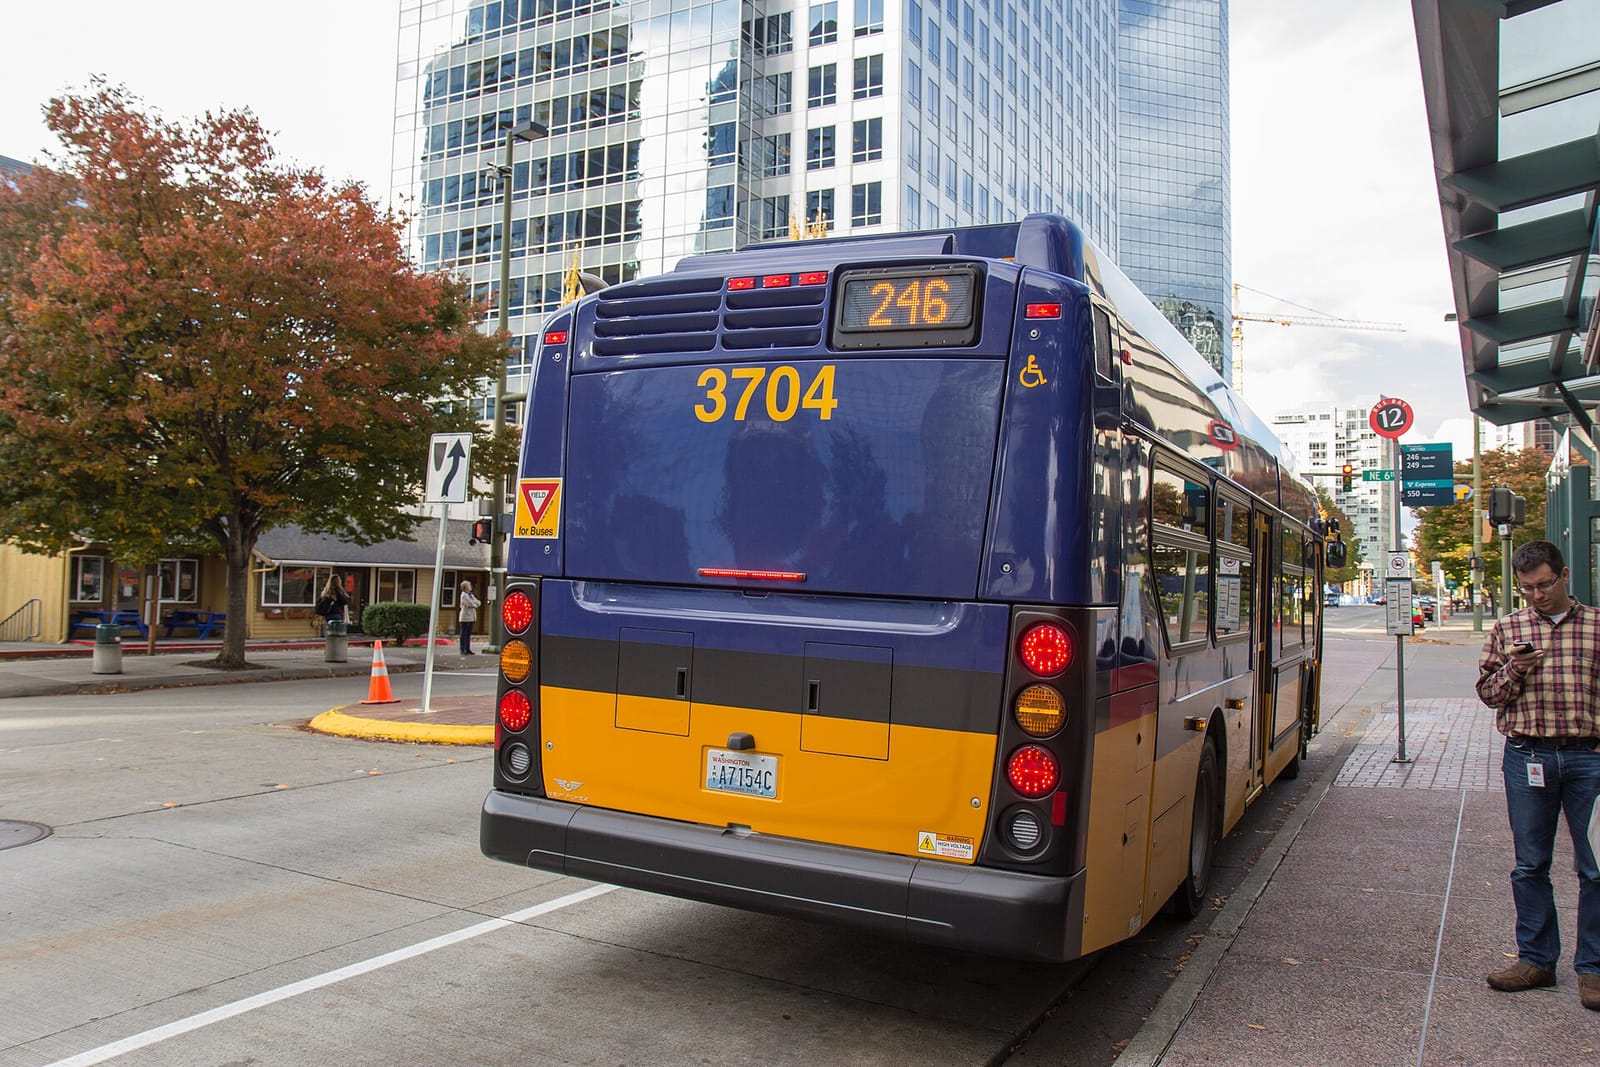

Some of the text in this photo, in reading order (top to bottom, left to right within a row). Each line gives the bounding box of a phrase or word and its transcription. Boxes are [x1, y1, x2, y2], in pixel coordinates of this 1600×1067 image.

[868, 280, 949, 327] 246
[694, 365, 838, 423] 3704
[1379, 407, 1404, 428] 12
[1369, 471, 1381, 481] NE
[519, 525, 554, 536] for Buses
[712, 756, 750, 767] WASHINGTON
[719, 765, 773, 790] A7154C
[946, 836, 970, 844] WARNING
